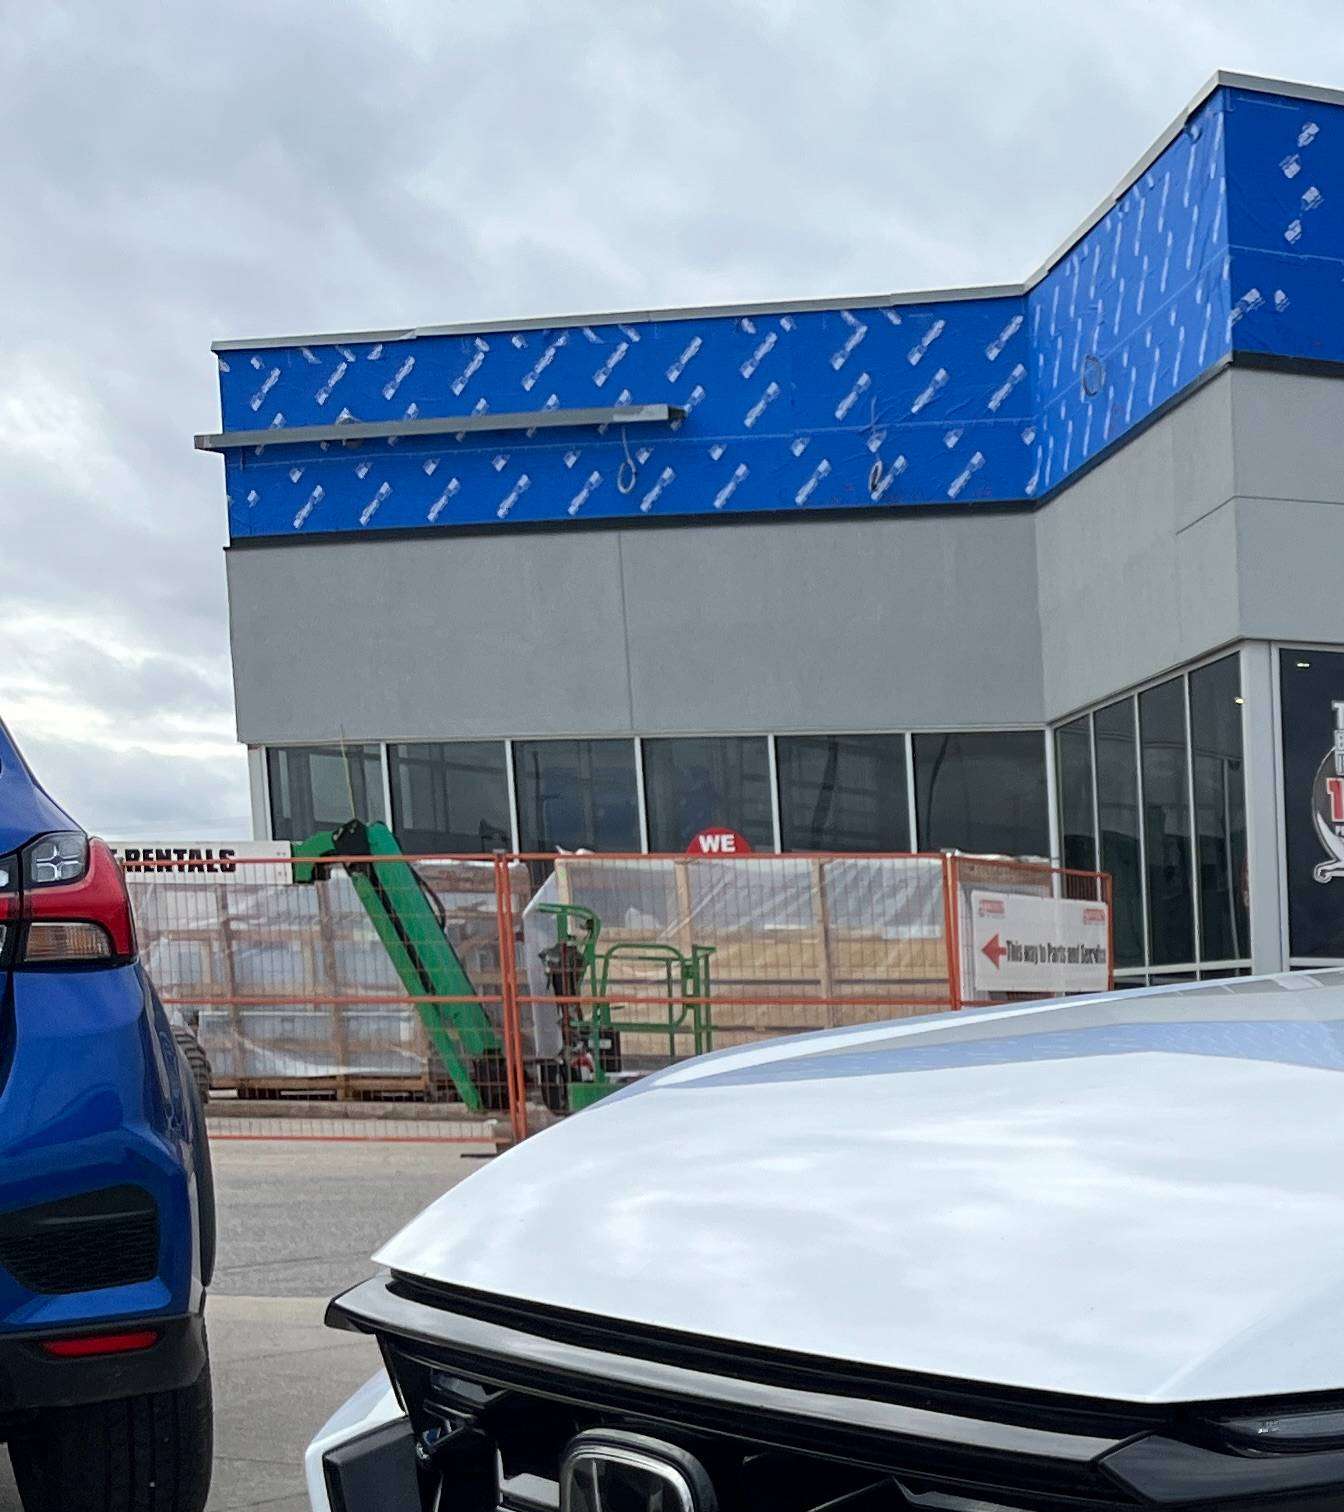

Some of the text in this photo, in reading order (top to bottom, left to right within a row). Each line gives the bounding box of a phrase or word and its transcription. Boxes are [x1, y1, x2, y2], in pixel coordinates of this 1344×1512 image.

[699, 833, 736, 853] WE
[125, 848, 236, 873] RENTALS
[1006, 940, 1022, 962] This
